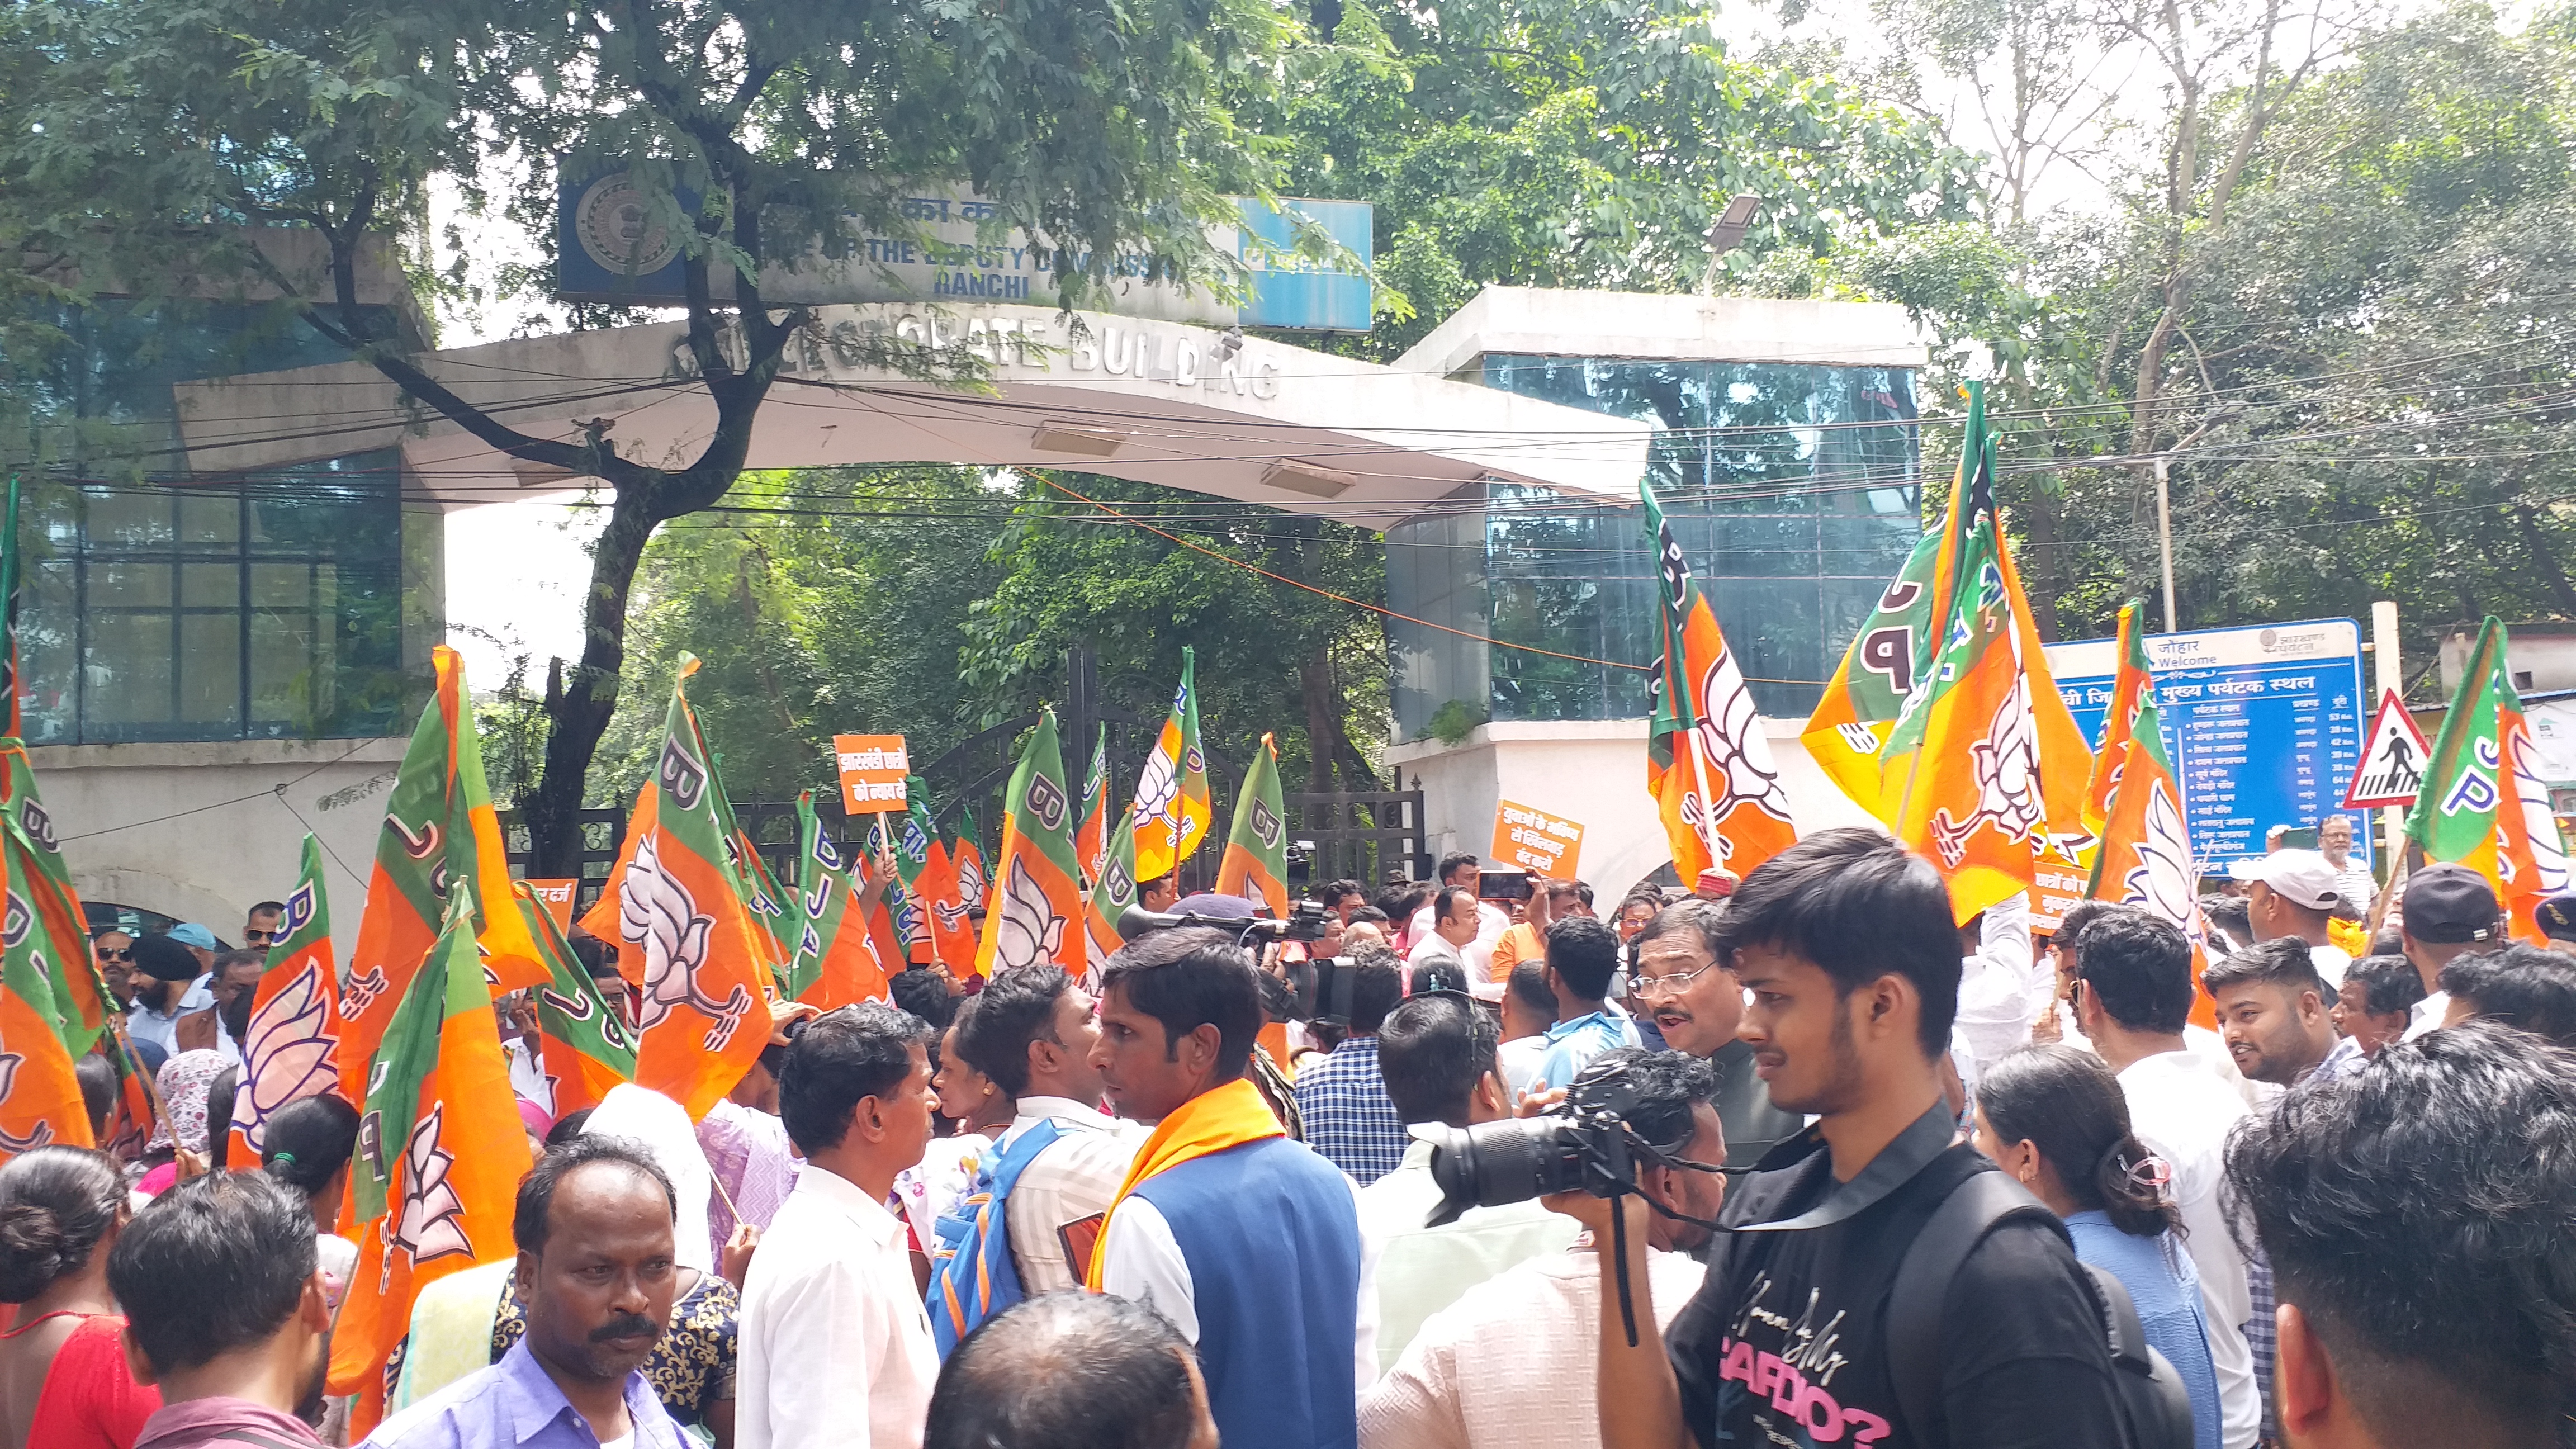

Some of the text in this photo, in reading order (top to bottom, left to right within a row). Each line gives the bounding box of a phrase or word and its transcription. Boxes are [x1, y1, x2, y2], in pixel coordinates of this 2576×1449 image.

[866, 238, 915, 264] THE
[934, 272, 1029, 299] RANCHI
[1071, 320, 1281, 399] BUILDING
[2158, 656, 2217, 667] Welcome
[2160, 685, 2203, 703] मुख्य
[2206, 676, 2264, 695] पर्यटक
[2269, 676, 2316, 691] स्थल
[851, 778, 869, 802] को
[868, 783, 896, 801] न्याय
